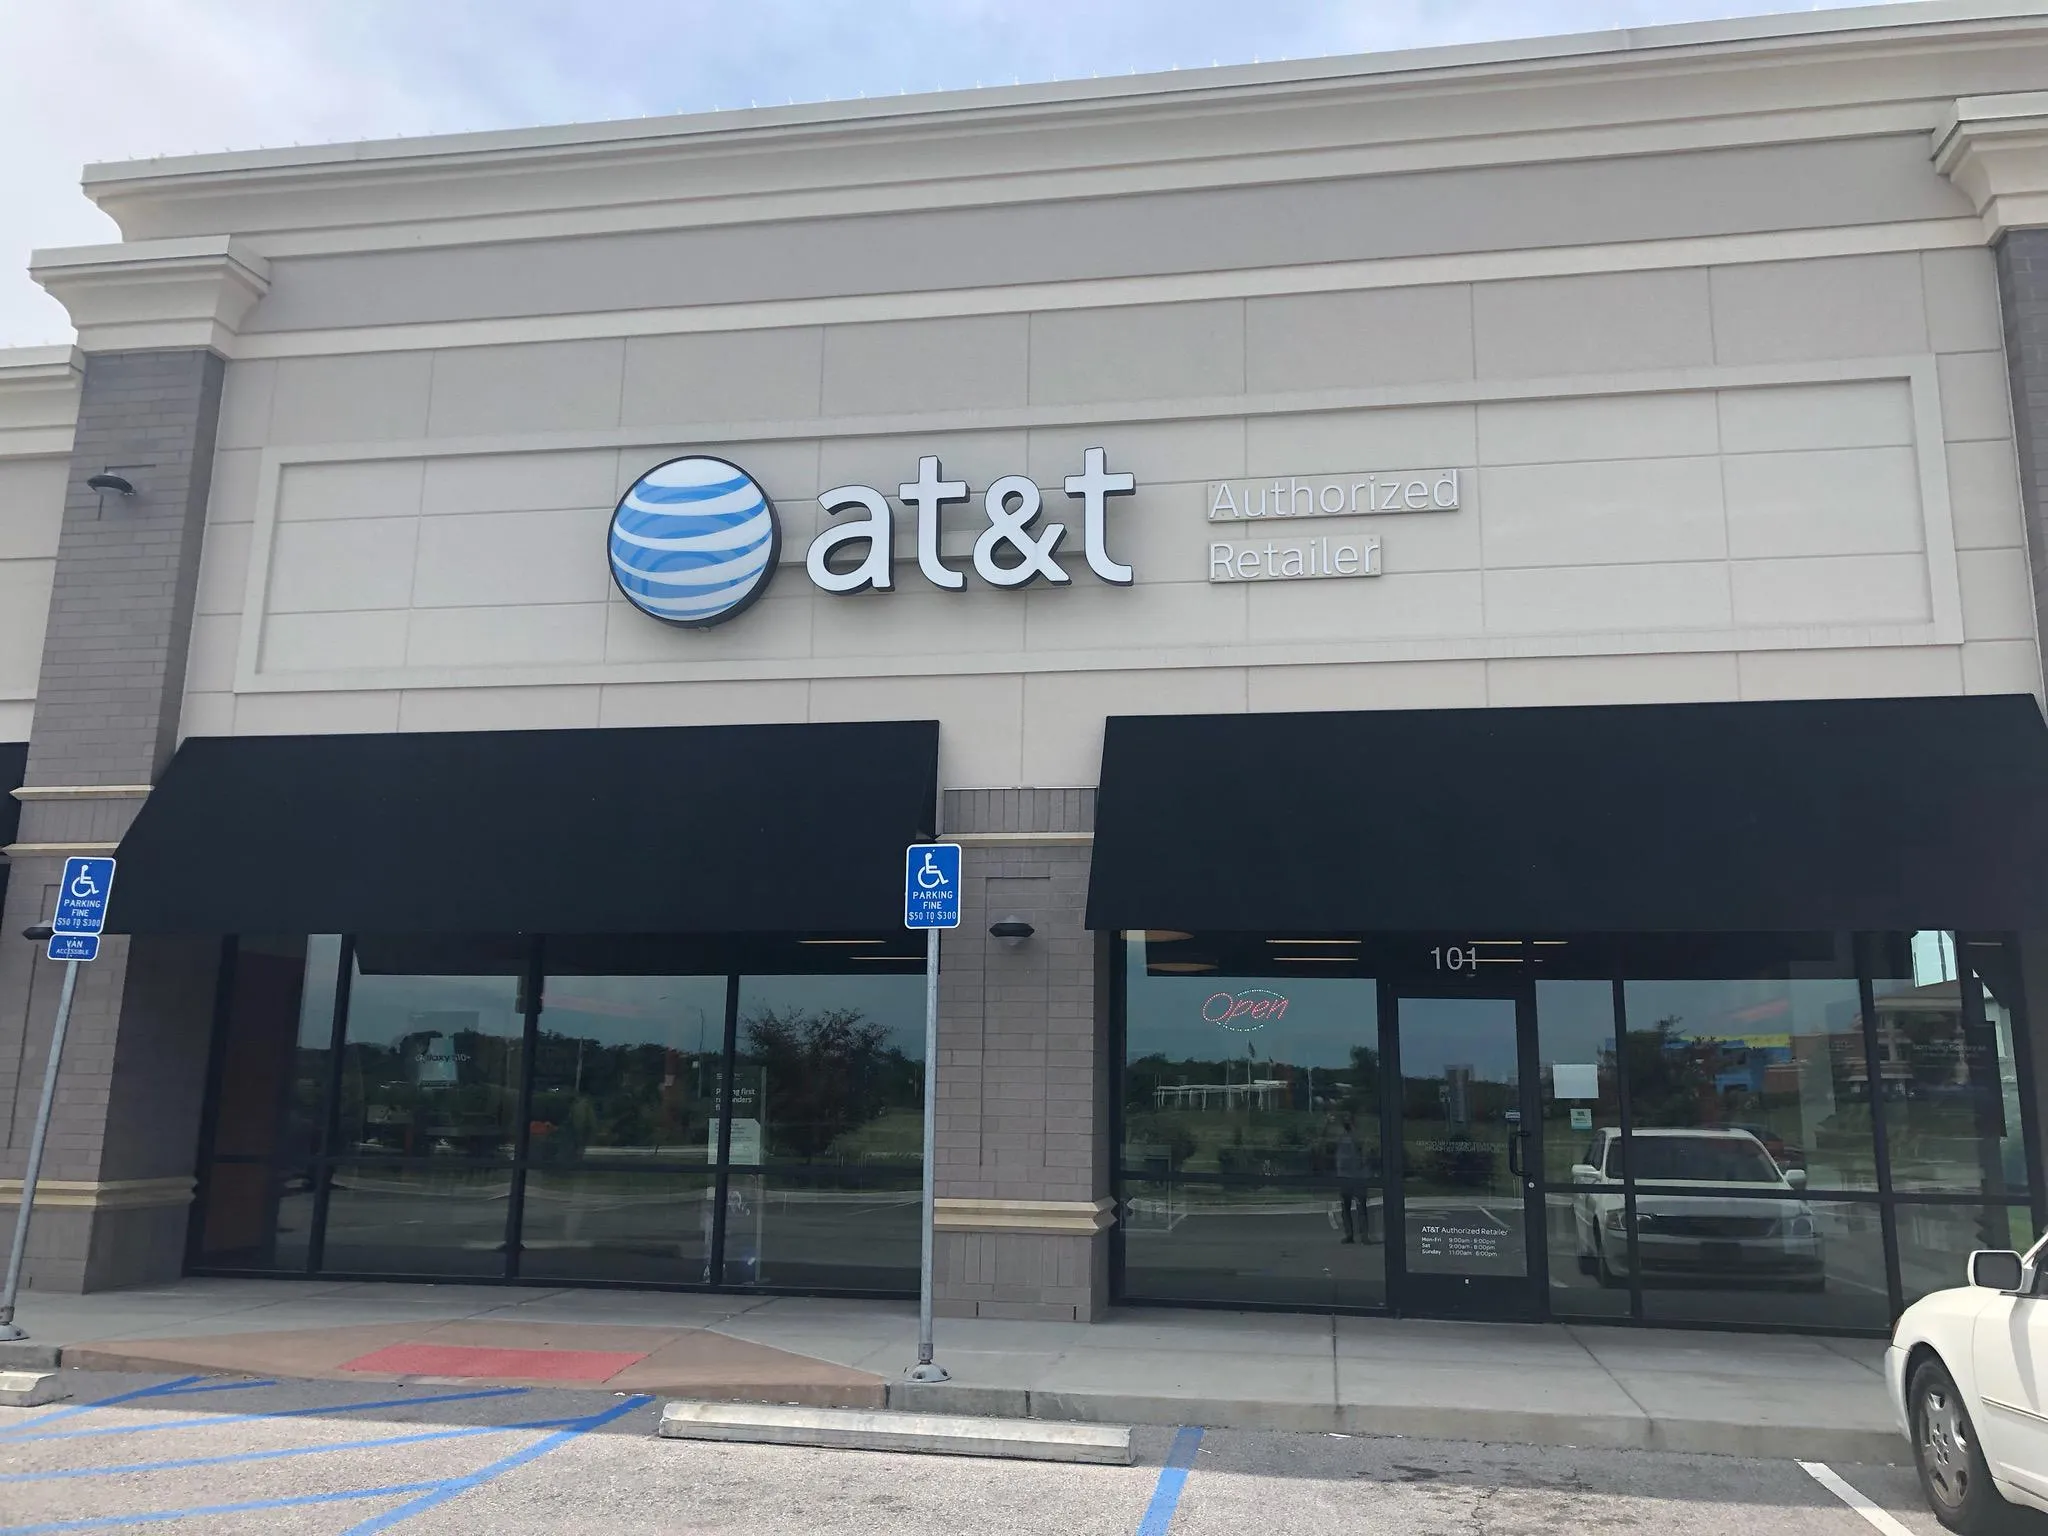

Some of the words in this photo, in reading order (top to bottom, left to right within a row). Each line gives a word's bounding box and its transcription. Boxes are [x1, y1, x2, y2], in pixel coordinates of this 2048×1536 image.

[1208, 468, 1459, 519] Authorized
[806, 447, 1137, 595] at&t
[1210, 536, 1379, 580] Retailer
[912, 890, 953, 900] PARKING
[63, 900, 101, 908] PARKING
[923, 901, 942, 910] FINE
[71, 909, 90, 917] FINE
[926, 911, 935, 920] TO
[72, 918, 81, 927] TO
[66, 940, 84, 948] VAN
[1430, 946, 1476, 970] 101
[1202, 992, 1289, 1025] Open
[1441, 1226, 1480, 1235] Authorized
[1481, 1227, 1508, 1236] Retailer
